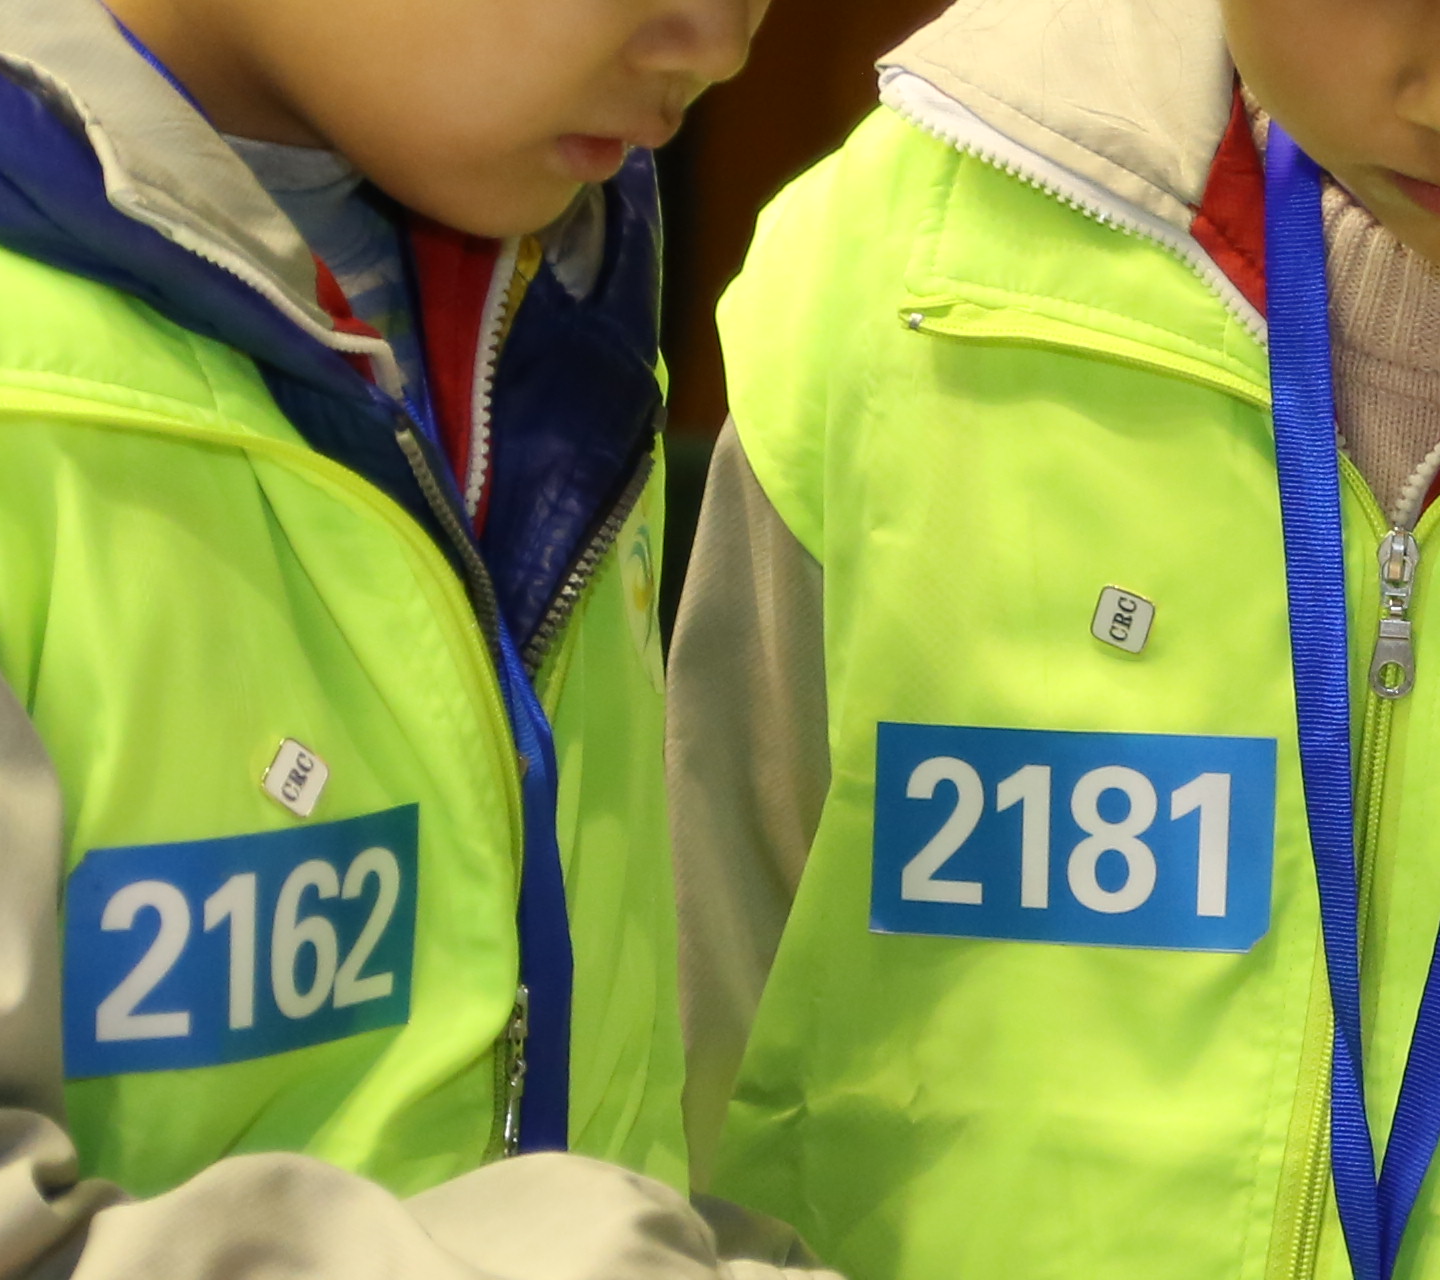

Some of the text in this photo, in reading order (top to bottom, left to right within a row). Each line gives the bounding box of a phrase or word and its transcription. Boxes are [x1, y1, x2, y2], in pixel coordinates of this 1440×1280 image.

[1108, 595, 1138, 642] CRC
[281, 751, 315, 802] CRC
[900, 755, 1231, 918] 2181
[95, 846, 401, 1043] 2162
